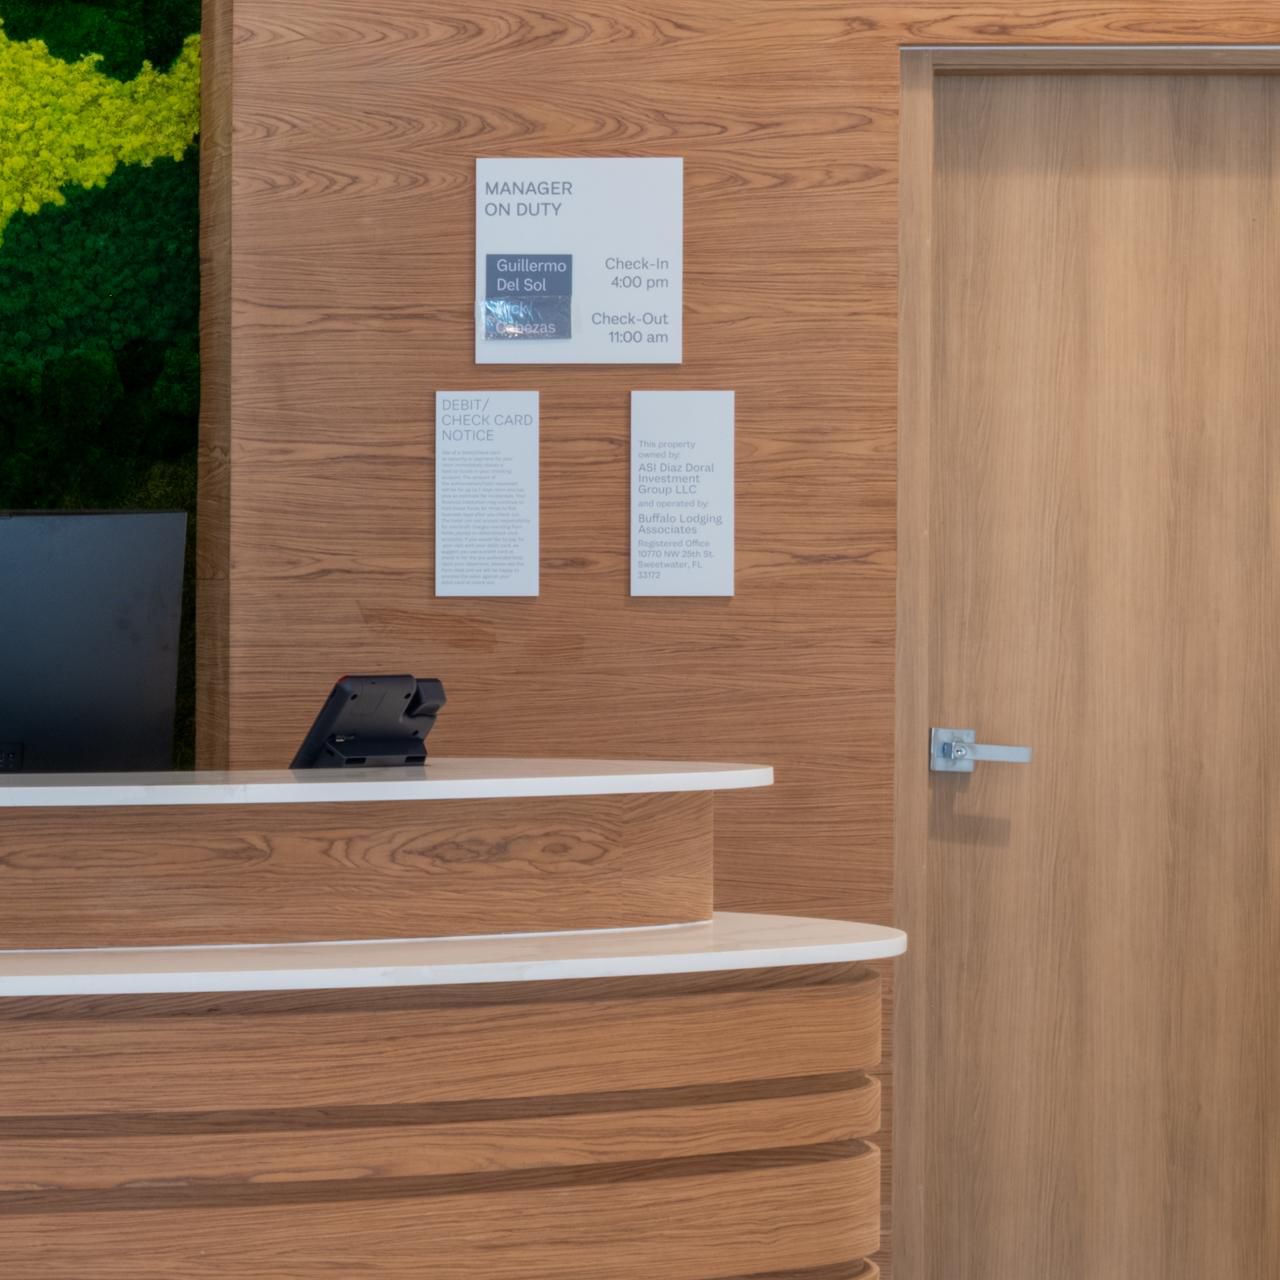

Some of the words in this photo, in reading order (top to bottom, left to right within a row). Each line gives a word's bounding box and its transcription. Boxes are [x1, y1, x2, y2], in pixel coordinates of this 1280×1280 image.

[485, 182, 573, 195] MANAGER
[485, 203, 510, 216] ON
[517, 203, 562, 216] DUTY
[497, 259, 567, 272] Guillermo
[605, 258, 669, 270] Check-In
[497, 279, 519, 291] Del
[524, 279, 546, 292] Sol
[611, 276, 642, 288] 4:00
[646, 278, 668, 291] pm
[592, 313, 669, 325] Check-Out
[609, 331, 642, 343] 11:00
[647, 334, 668, 343] am
[442, 398, 490, 411] DEBIT/
[442, 415, 491, 426] CHECK
[494, 415, 533, 426] CARD
[442, 430, 494, 441] NOTICE
[659, 441, 695, 451] property
[660, 463, 682, 472] Diaz
[686, 463, 714, 472] Doral
[639, 474, 700, 483] Investment
[639, 485, 672, 496] Group
[676, 485, 696, 494] LLC
[639, 514, 676, 523] Buffalo
[680, 514, 723, 525] Lodging
[638, 525, 697, 534] Associates
